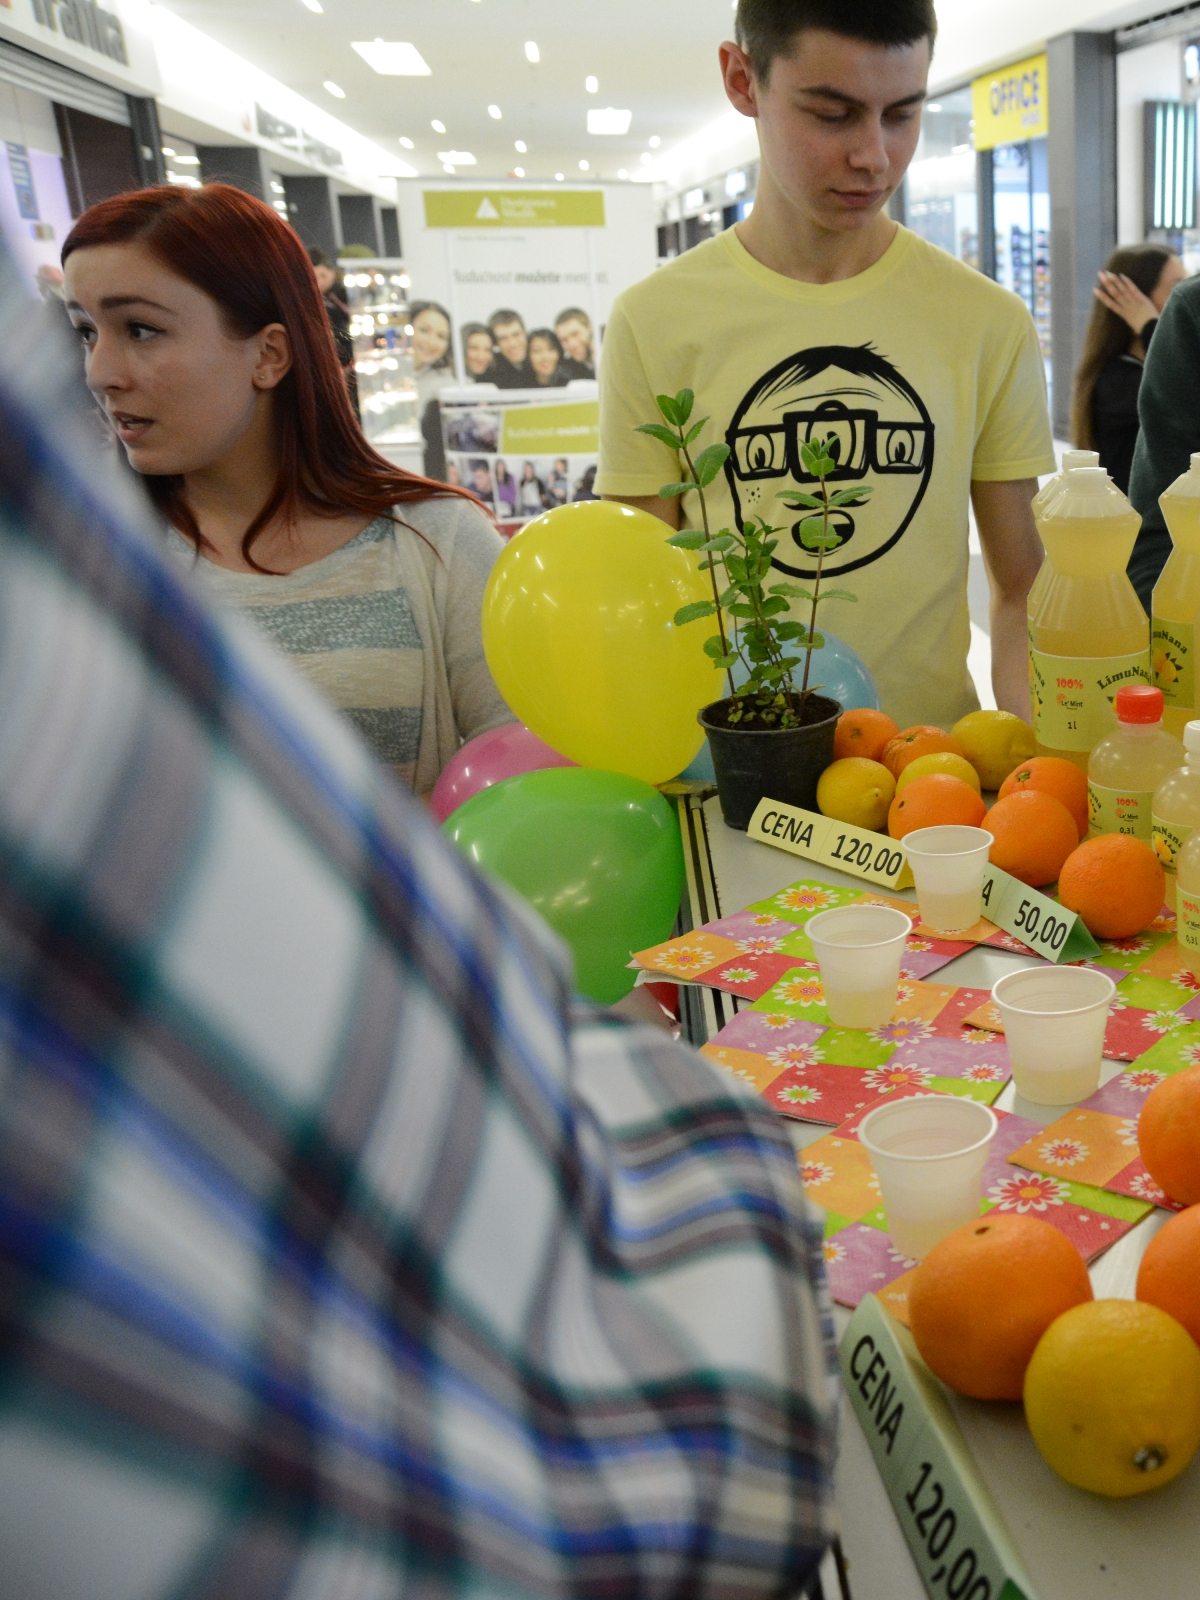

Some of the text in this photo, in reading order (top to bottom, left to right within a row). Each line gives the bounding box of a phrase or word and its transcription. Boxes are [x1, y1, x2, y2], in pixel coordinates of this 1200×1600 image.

[990, 68, 1041, 116] OFFICE
[1056, 677, 1084, 690] 100%
[760, 811, 903, 877] CENA 120,00
[1013, 899, 1068, 950] 50,00
[850, 1335, 904, 1455] CENA
